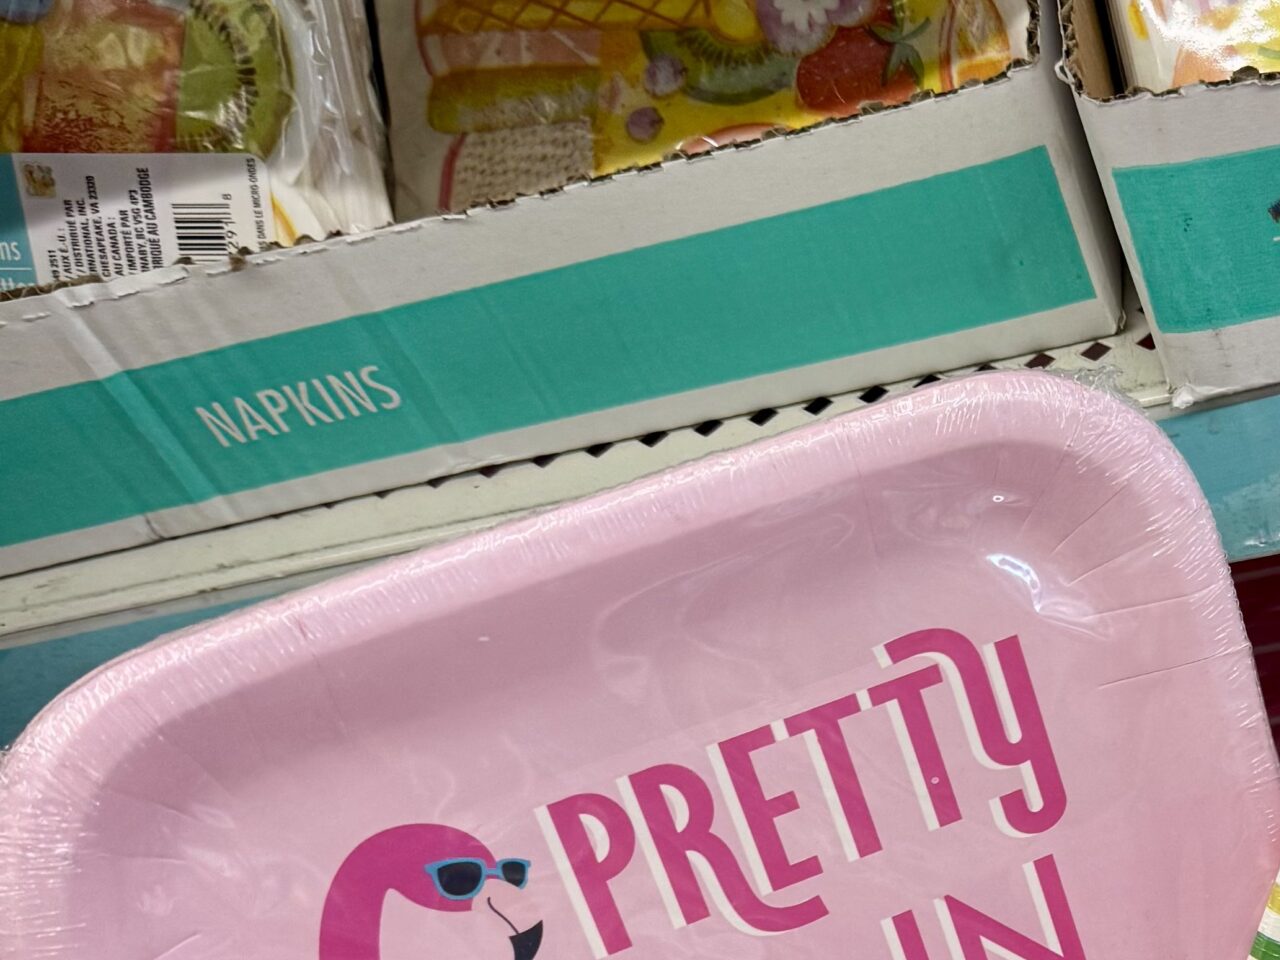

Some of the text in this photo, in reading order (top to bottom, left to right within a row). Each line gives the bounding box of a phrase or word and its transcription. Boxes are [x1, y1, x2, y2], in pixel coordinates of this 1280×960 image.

[136, 167, 157, 221] CAMBODGE
[63, 200, 74, 218] PAR
[89, 202, 100, 214] VA
[119, 209, 131, 228] PAR
[146, 222, 160, 236] AU
[107, 222, 121, 261] CANADA
[114, 263, 125, 276] AU
[195, 365, 401, 448] NAPKINS
[533, 627, 1068, 960] PRETTY
